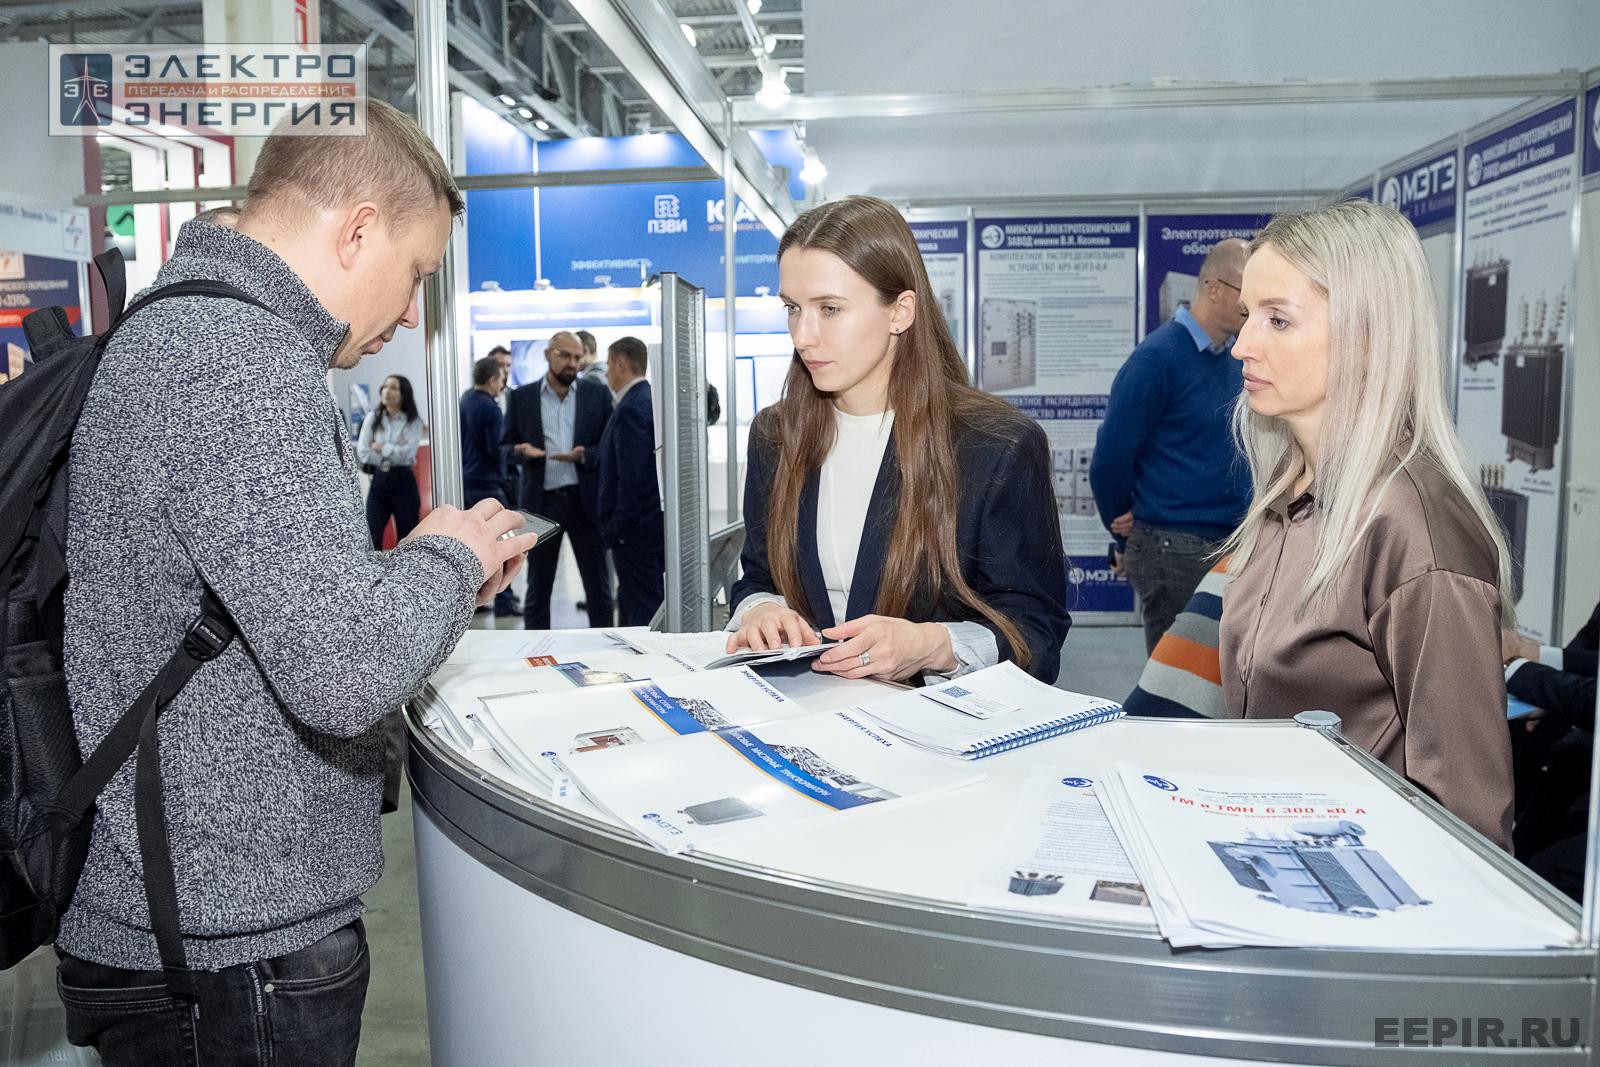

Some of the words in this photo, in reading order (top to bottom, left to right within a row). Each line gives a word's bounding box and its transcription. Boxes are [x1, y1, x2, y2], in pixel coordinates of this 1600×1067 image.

[1403, 155, 1456, 204] МЭТЗ
[835, 712, 867, 731] ЭНЕРГИЯ
[864, 729, 892, 747] УСПЕХА
